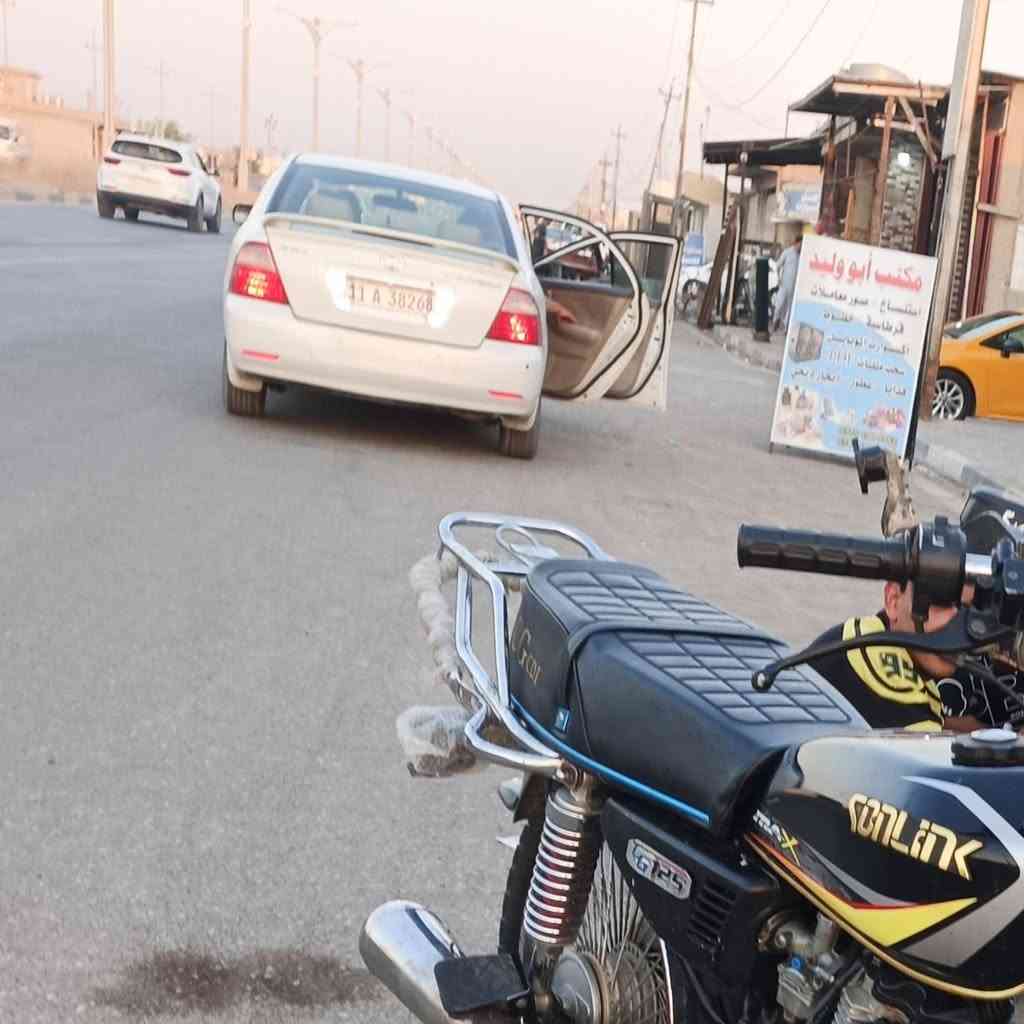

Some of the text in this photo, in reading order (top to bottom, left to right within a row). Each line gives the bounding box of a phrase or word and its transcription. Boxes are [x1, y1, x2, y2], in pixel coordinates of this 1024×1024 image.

[809, 252, 845, 281] وليد
[875, 264, 922, 292] مكتب
[372, 287, 381, 304] A
